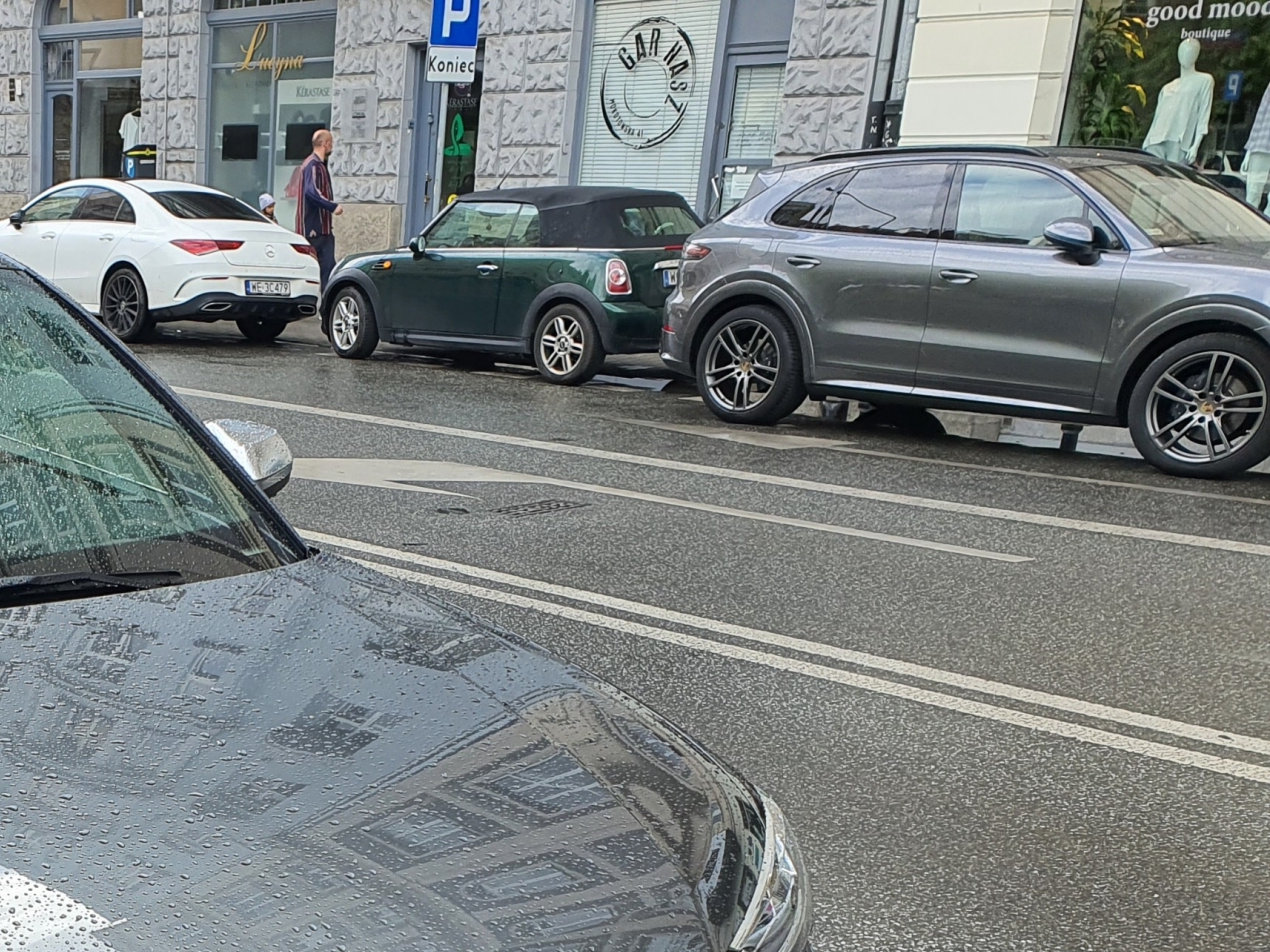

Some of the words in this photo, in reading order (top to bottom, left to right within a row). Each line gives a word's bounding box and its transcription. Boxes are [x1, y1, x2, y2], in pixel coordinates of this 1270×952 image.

[442, 0, 470, 37] P
[1146, 0, 1203, 28] good
[1181, 27, 1231, 41] boutique
[618, 28, 661, 70] GAR
[429, 55, 474, 73] Koniec
[251, 281, 262, 293] WE
[264, 282, 289, 293] 3C479
